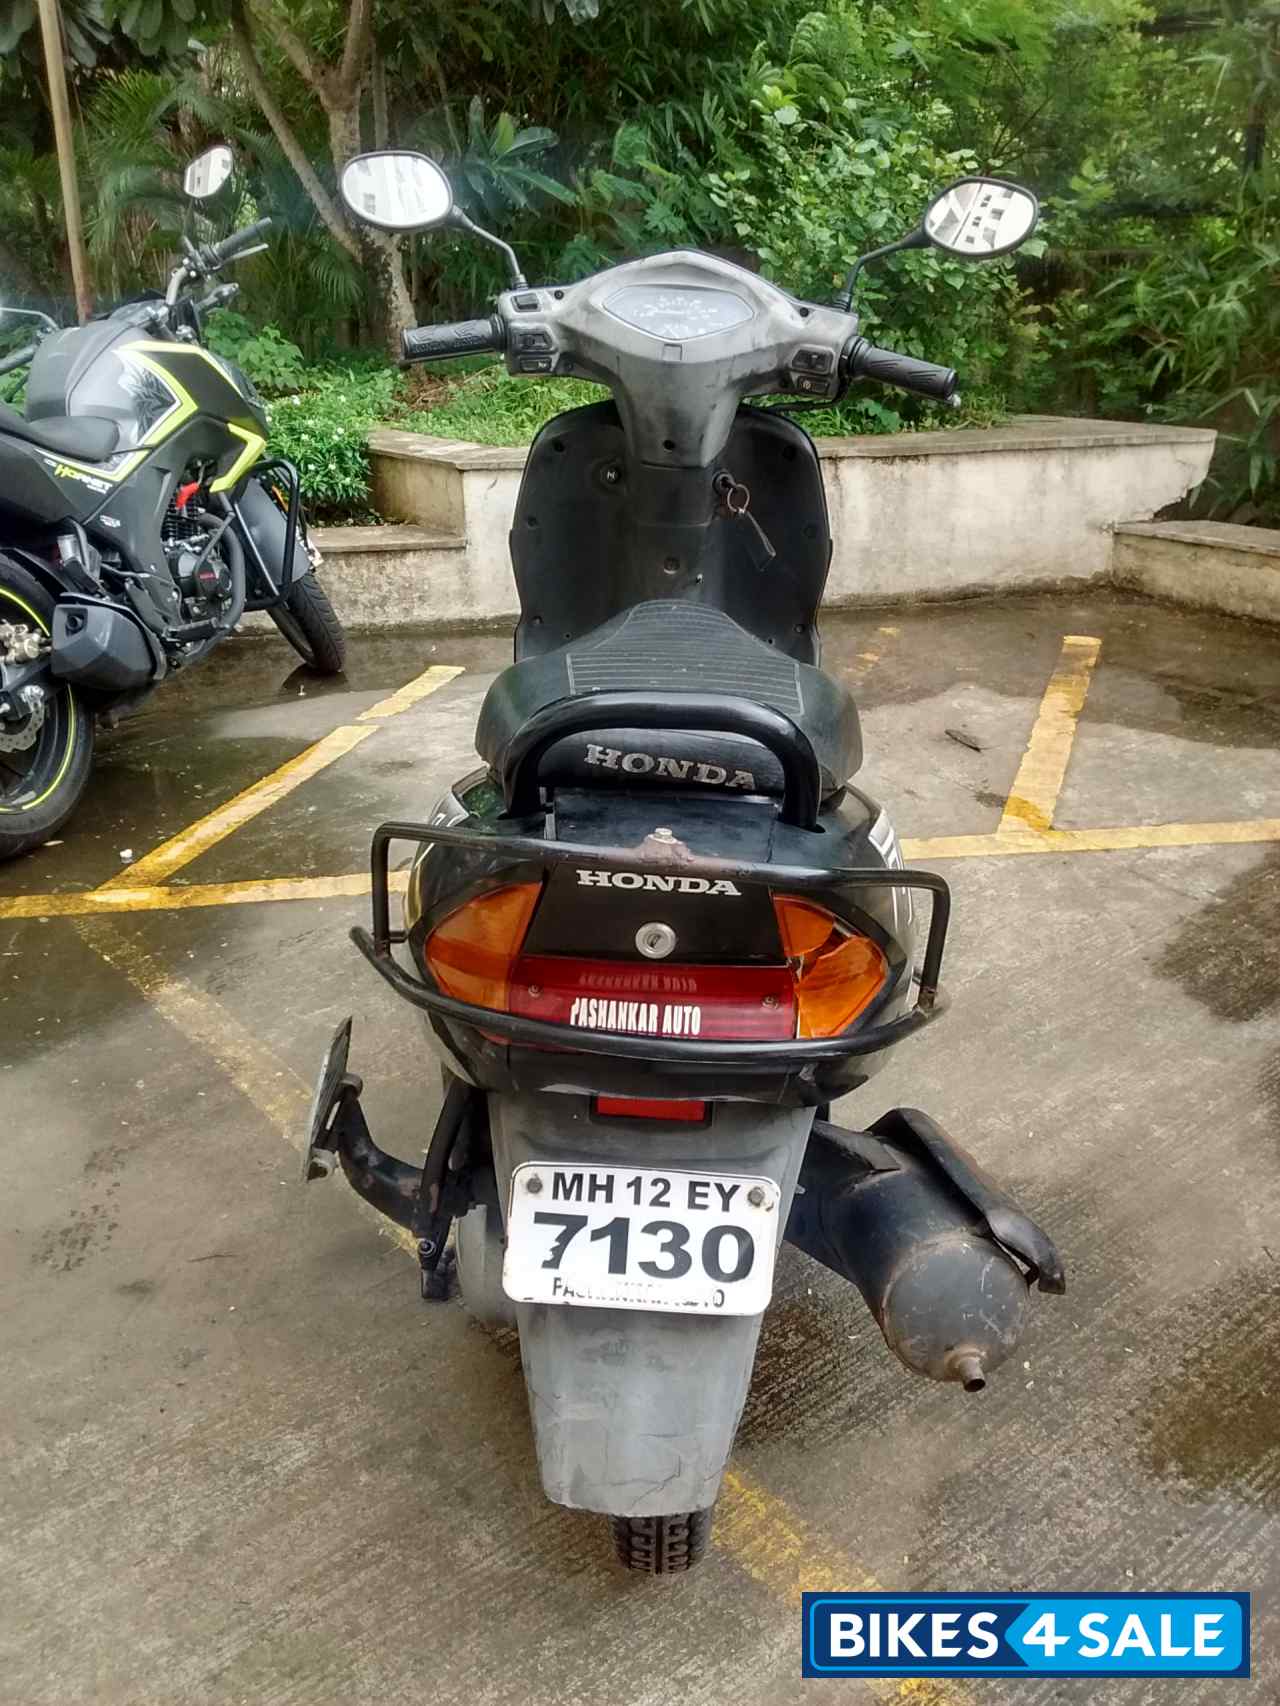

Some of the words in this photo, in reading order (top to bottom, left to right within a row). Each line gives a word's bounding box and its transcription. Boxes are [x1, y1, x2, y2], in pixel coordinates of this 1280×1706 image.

[584, 744, 756, 790] HONDA
[576, 869, 742, 896] HONDA
[662, 1004, 701, 1035] AUTO
[552, 1172, 615, 1204] MH
[626, 1176, 671, 1208] 12
[687, 1180, 740, 1212] EY
[533, 1211, 755, 1283] 7130
